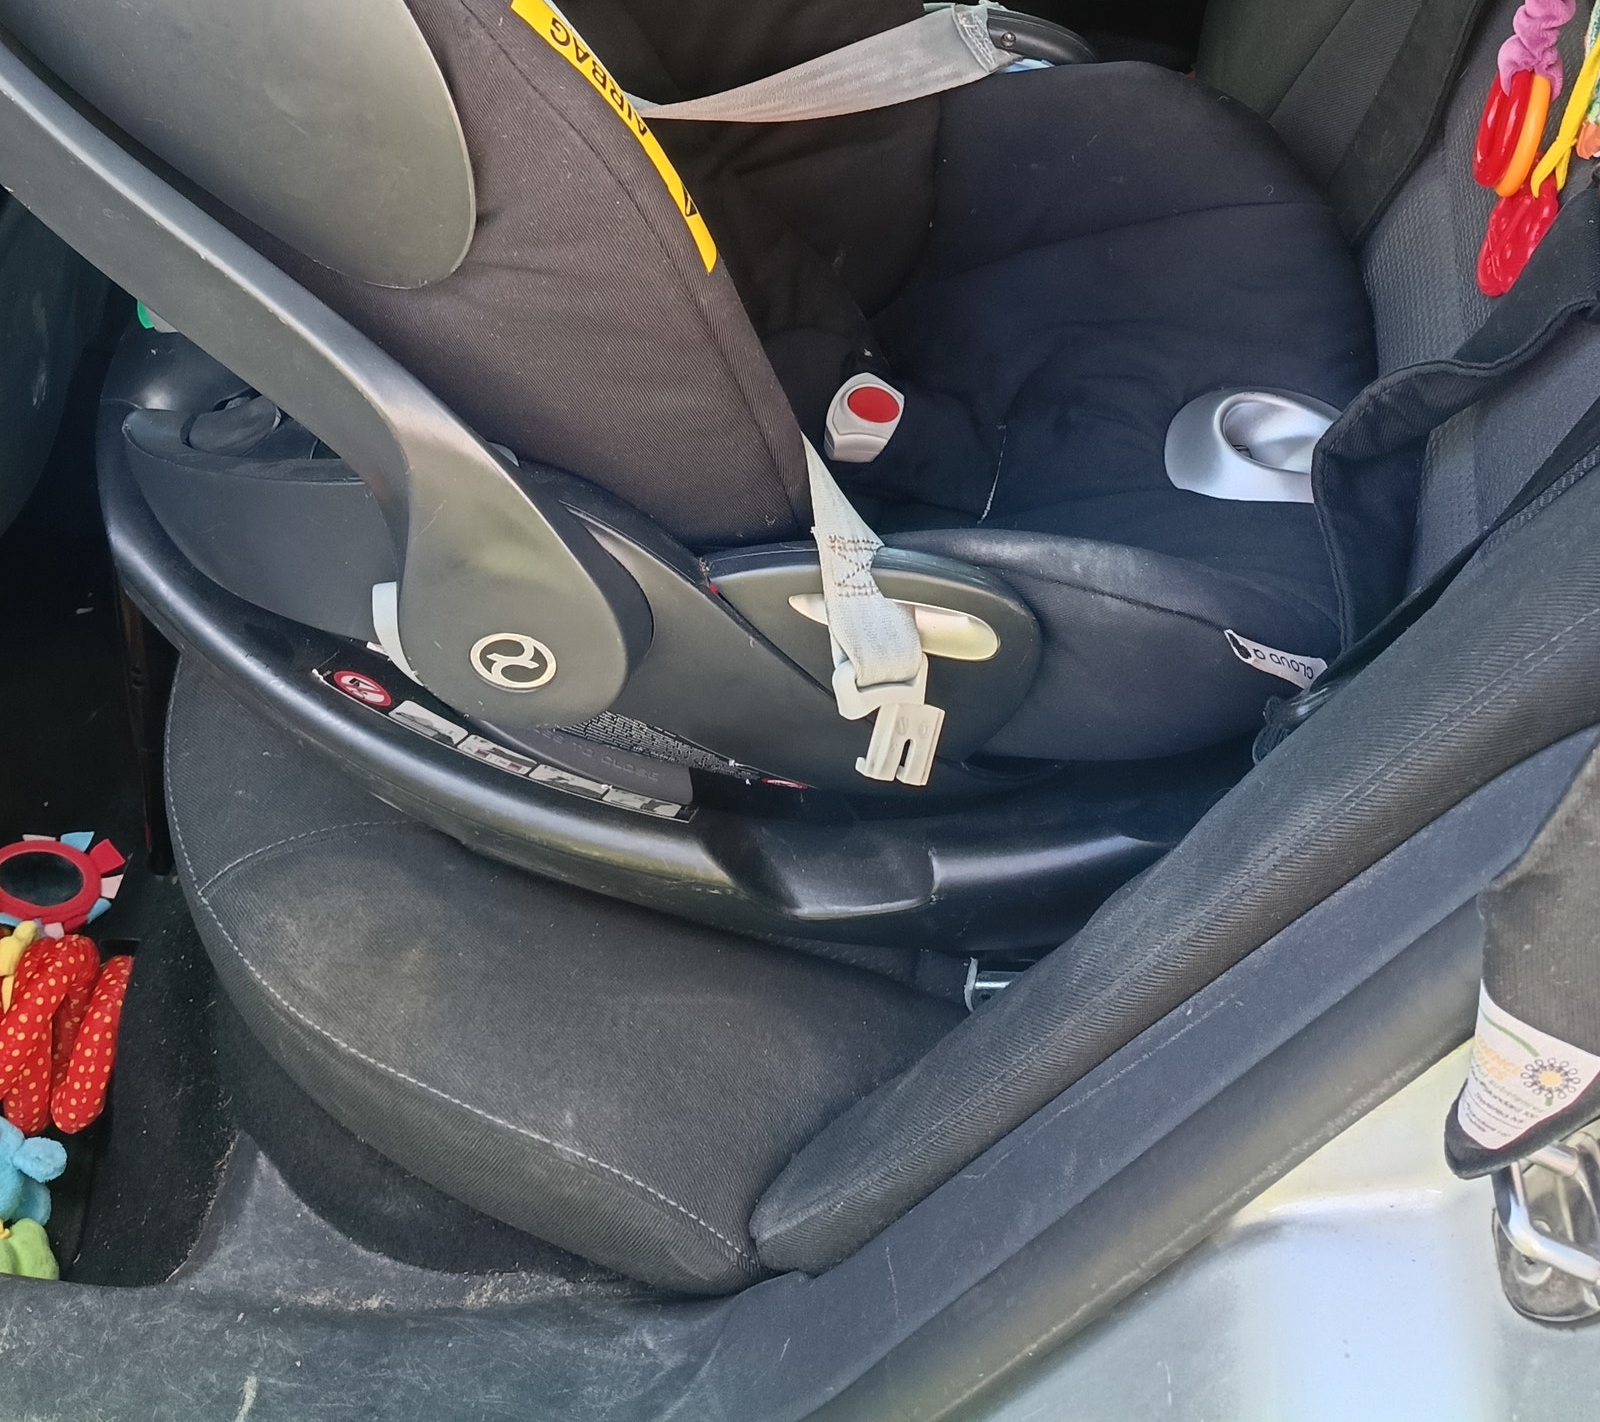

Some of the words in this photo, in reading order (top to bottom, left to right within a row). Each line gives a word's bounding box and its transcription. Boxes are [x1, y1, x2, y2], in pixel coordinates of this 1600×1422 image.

[549, 17, 648, 136] AIRBAG
[1252, 648, 1266, 661] Q
[1269, 653, 1314, 680] CLOUD
